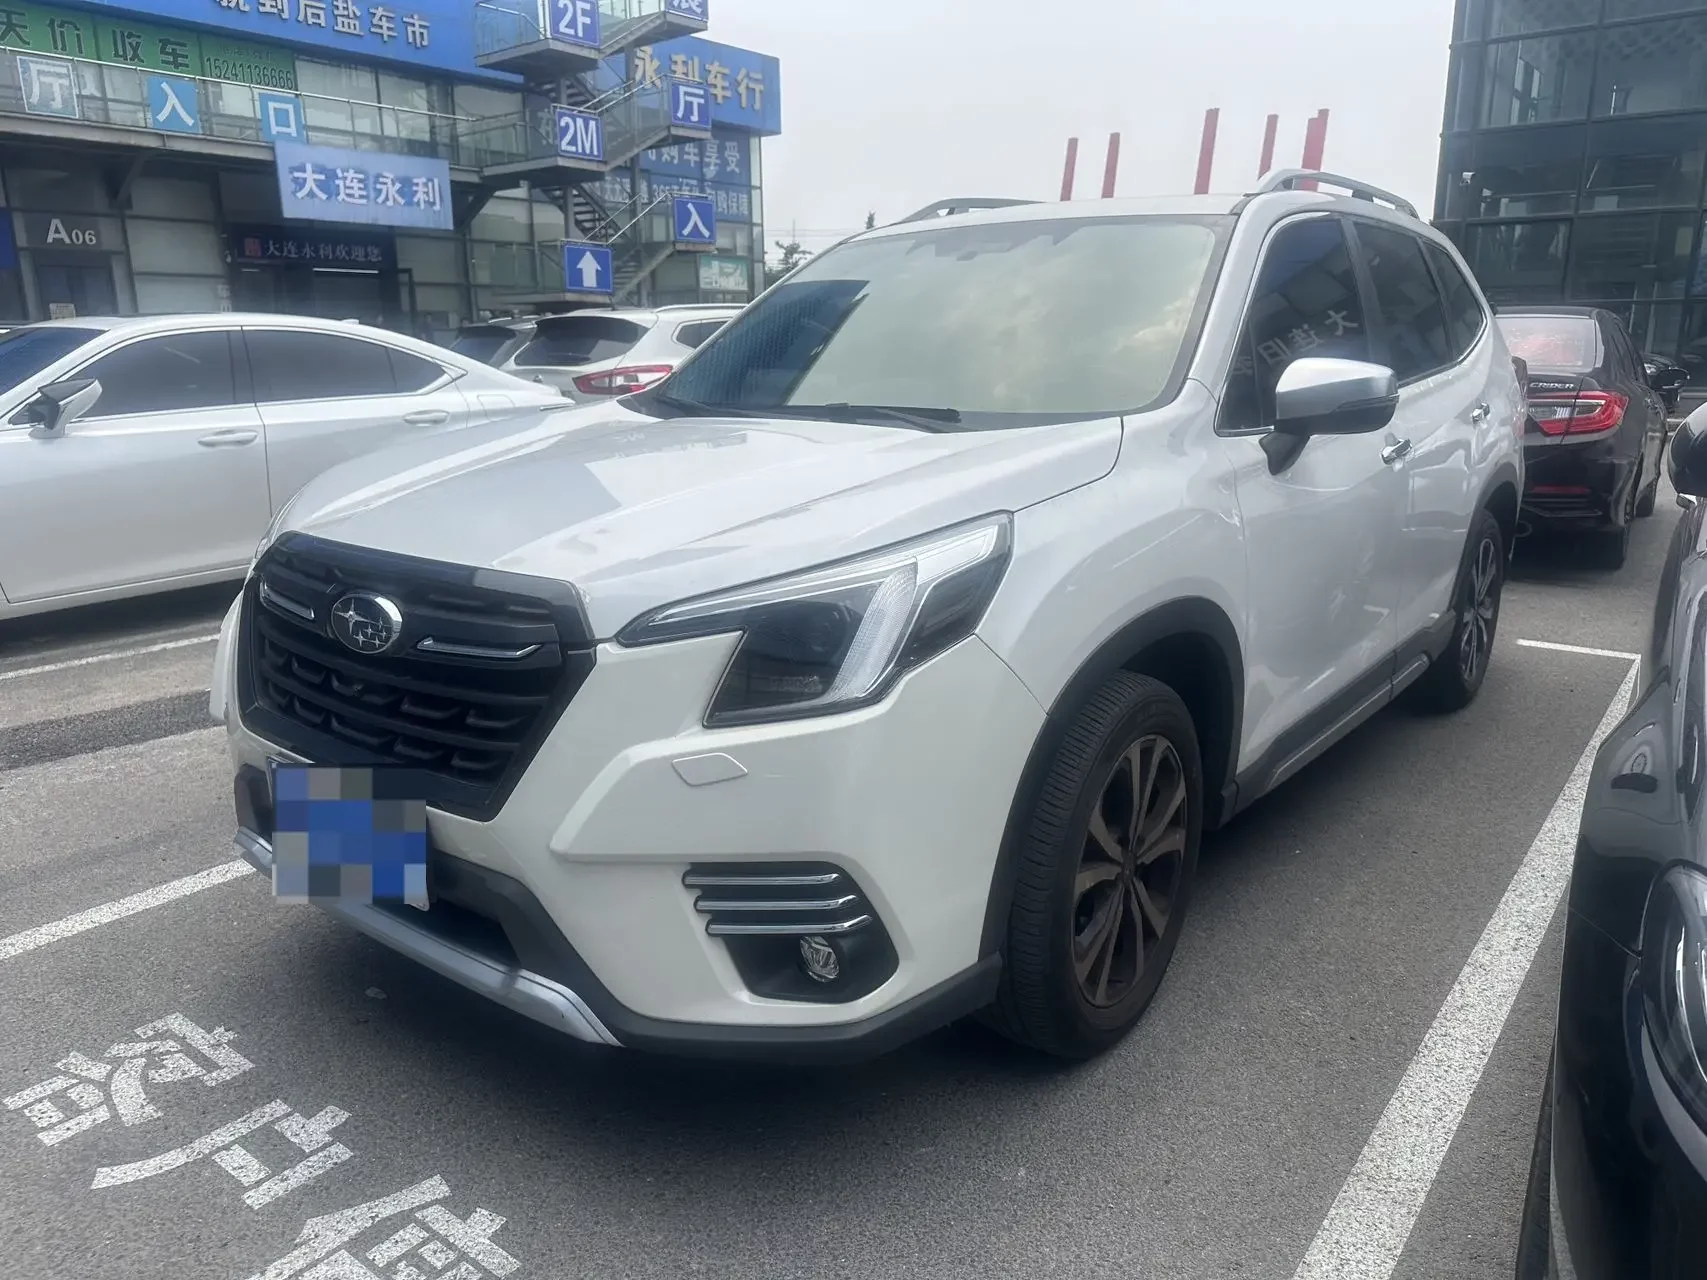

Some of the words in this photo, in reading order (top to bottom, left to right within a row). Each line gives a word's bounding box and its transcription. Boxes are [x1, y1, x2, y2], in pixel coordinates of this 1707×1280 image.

[558, 0, 593, 38] 2F
[0, 8, 191, 70] 天价收车
[205, 56, 294, 90] 15241136666
[634, 46, 765, 111] 永利车行
[676, 84, 706, 122] 厅
[559, 116, 598, 156] 2M
[291, 161, 442, 212] 大连永利
[46, 218, 97, 247] A06
[680, 201, 711, 239] 入
